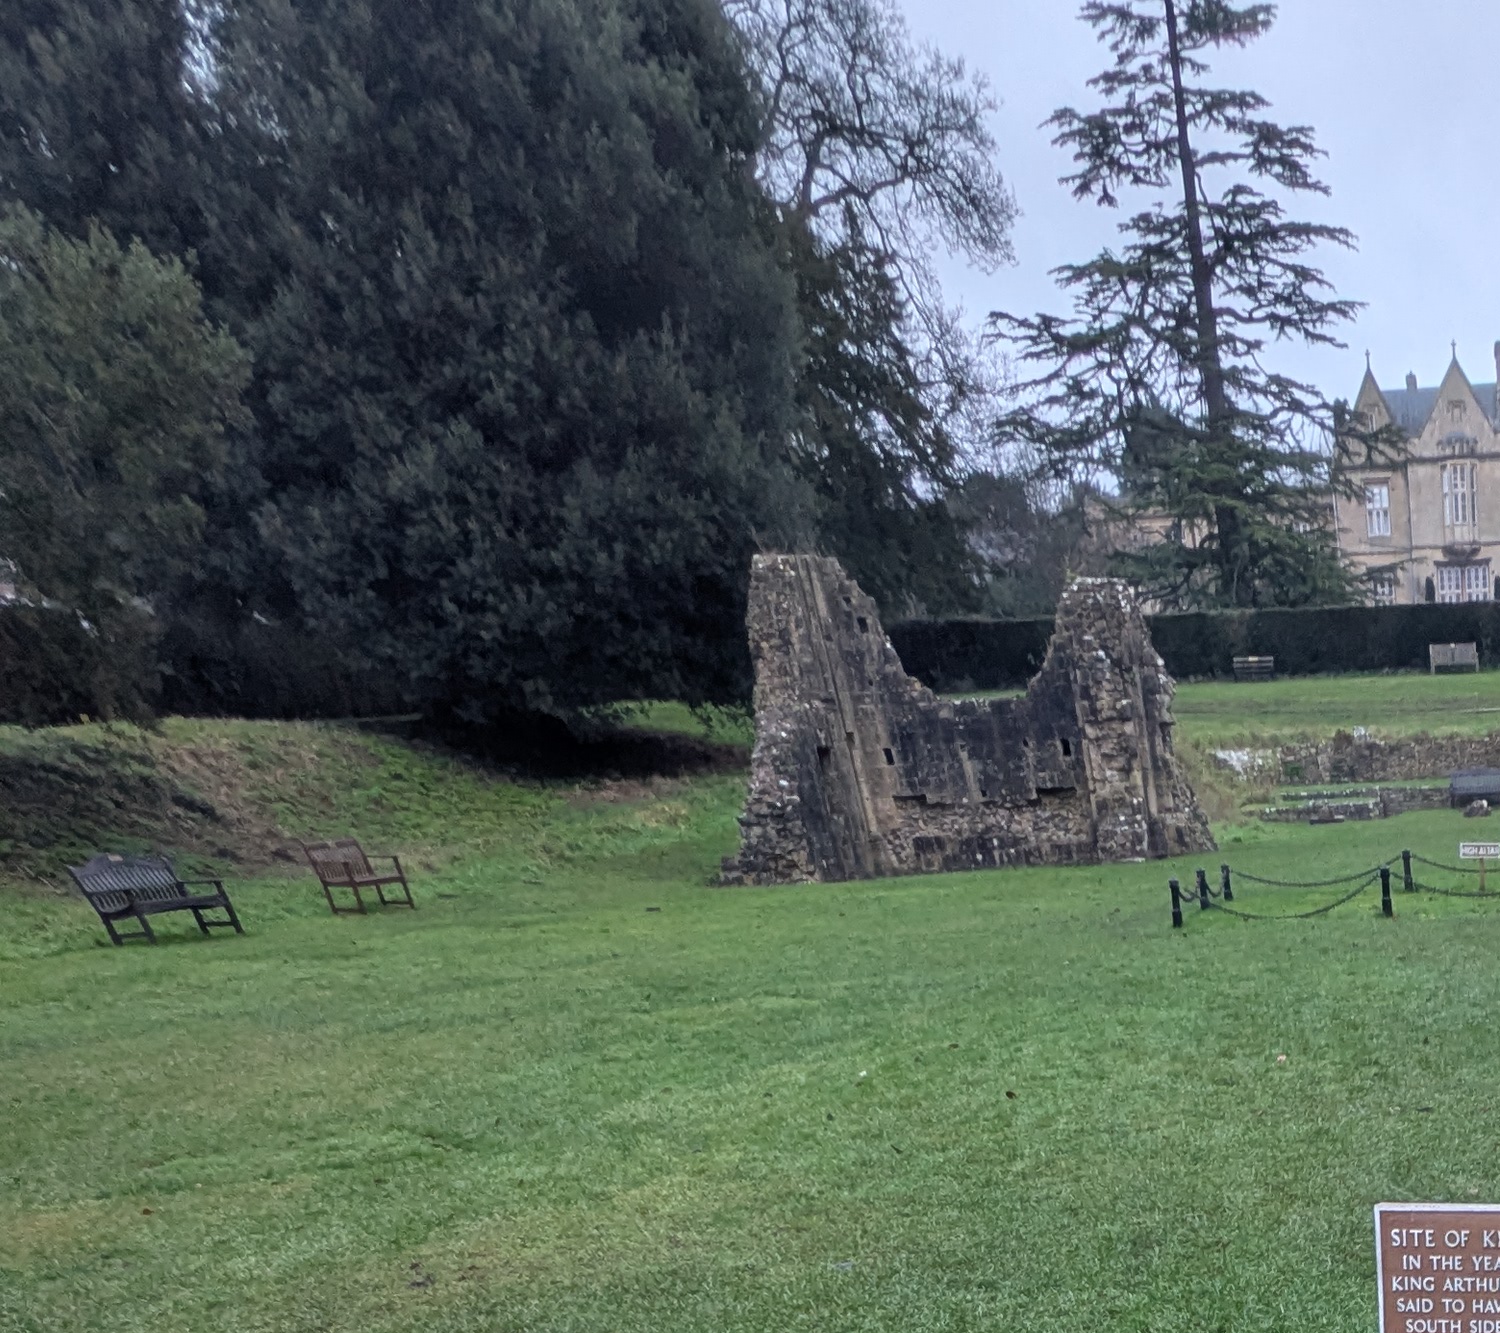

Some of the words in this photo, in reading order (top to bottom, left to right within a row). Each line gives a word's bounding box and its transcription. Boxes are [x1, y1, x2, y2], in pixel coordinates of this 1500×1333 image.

[1390, 1228, 1435, 1247] SITE
[1444, 1229, 1470, 1247] OF
[1402, 1254, 1421, 1270] IN
[1429, 1255, 1463, 1271] THE
[1392, 1276, 1435, 1291] KING
[1396, 1297, 1433, 1313] SAID
[1441, 1298, 1465, 1313] TO
[1405, 1318, 1462, 1333] SOUTH
